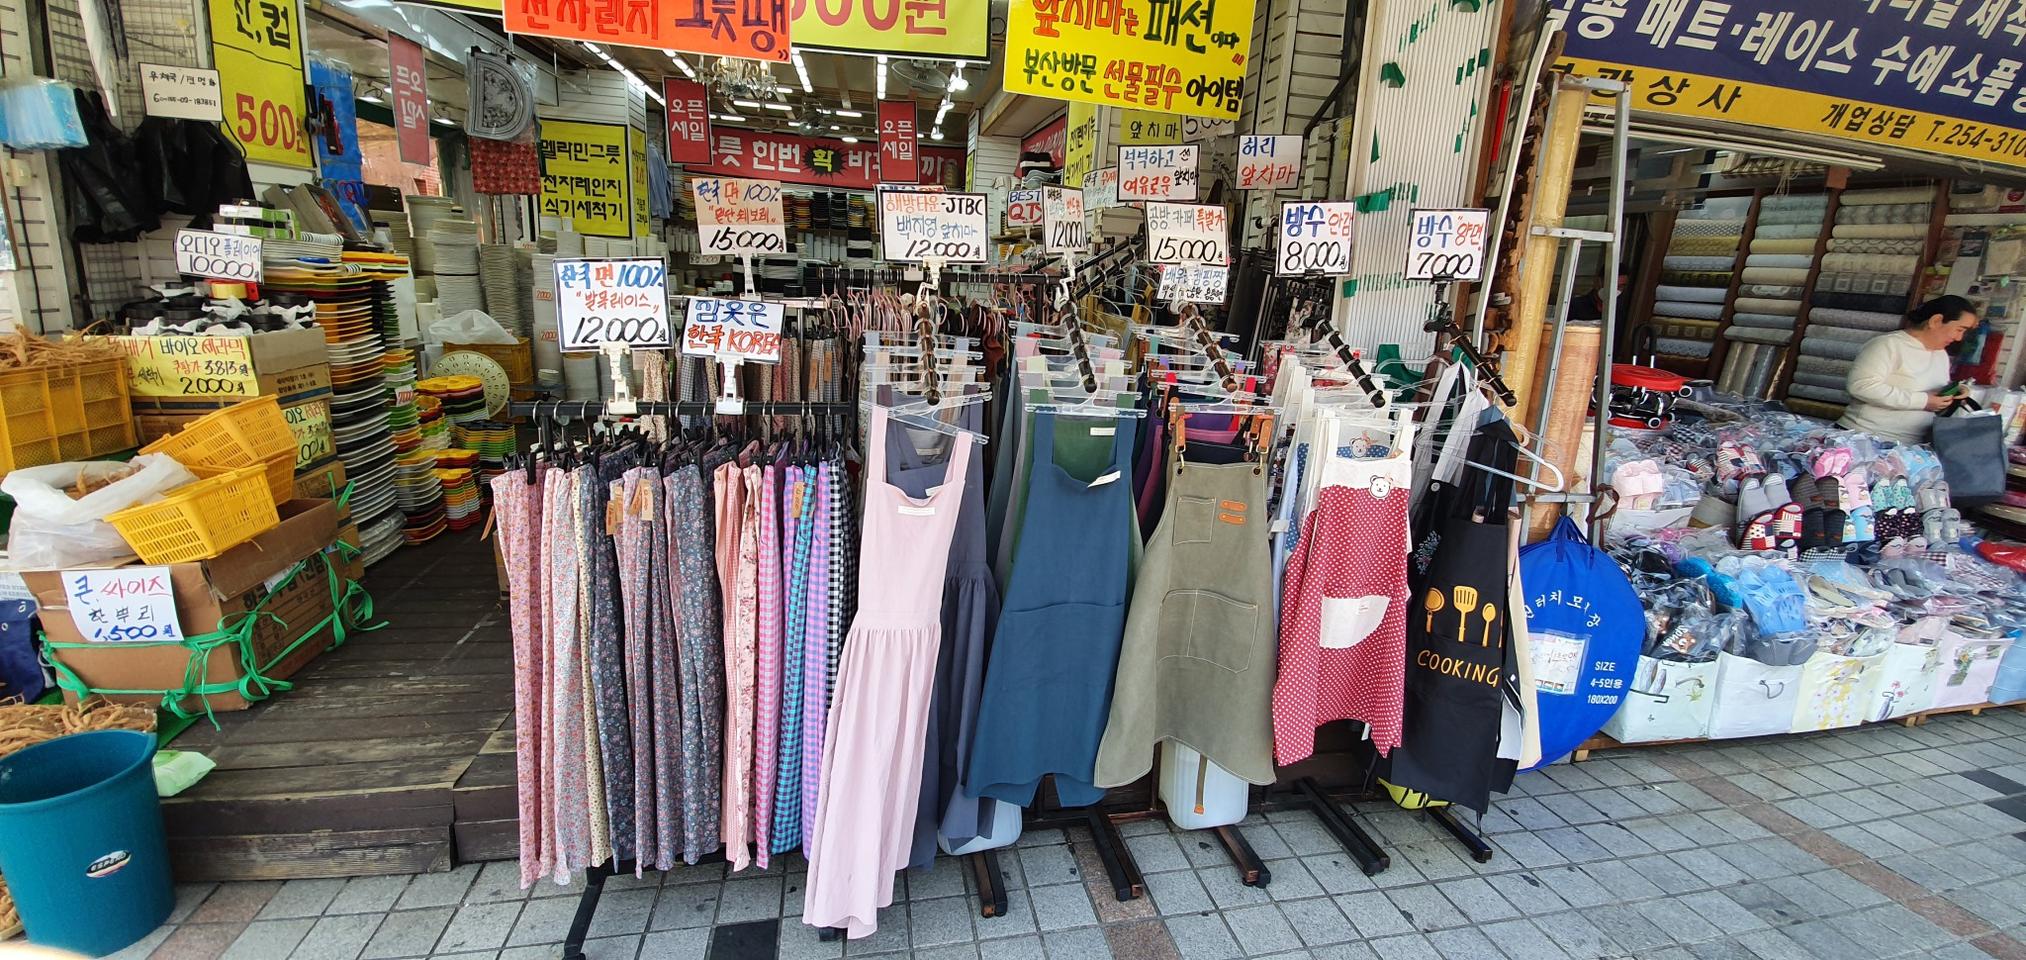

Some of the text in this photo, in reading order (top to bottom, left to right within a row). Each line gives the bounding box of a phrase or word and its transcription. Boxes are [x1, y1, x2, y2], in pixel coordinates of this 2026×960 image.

[1023, 48, 1244, 113] 부산방문 선물필수 아이템
[671, 98, 704, 121] 오픈
[1821, 102, 1916, 138] 개업상담
[671, 120, 705, 142] 세일
[882, 120, 914, 139] 오픈
[1130, 120, 1179, 140] 앞치마
[882, 140, 913, 161] 세일
[1241, 136, 1276, 158] 허리
[812, 148, 834, 172] 확
[543, 174, 622, 199] 전자레인지
[1123, 175, 1171, 196] 여유로운
[1240, 162, 1296, 187] 앞치마
[724, 181, 740, 206] 면
[743, 183, 780, 203] 100%
[1009, 190, 1041, 202] BEST
[545, 198, 623, 222] 식기세척기
[1149, 205, 1226, 234] 공방 카페 특별가
[1285, 204, 1325, 238] 방수
[896, 215, 938, 240] 백지영
[1416, 214, 1454, 249] 방수
[179, 234, 222, 258] 오디오
[1416, 252, 1474, 276] 7.000
[560, 263, 664, 290] 한국 면 100%
[160, 338, 201, 356] 바이오
[687, 324, 781, 356] 한국 KOREA
[173, 360, 202, 375] 쿠팡가
[101, 575, 173, 599] 싸이즈
[1417, 649, 1500, 688] COOKING
[1594, 661, 1616, 672] SIZE
